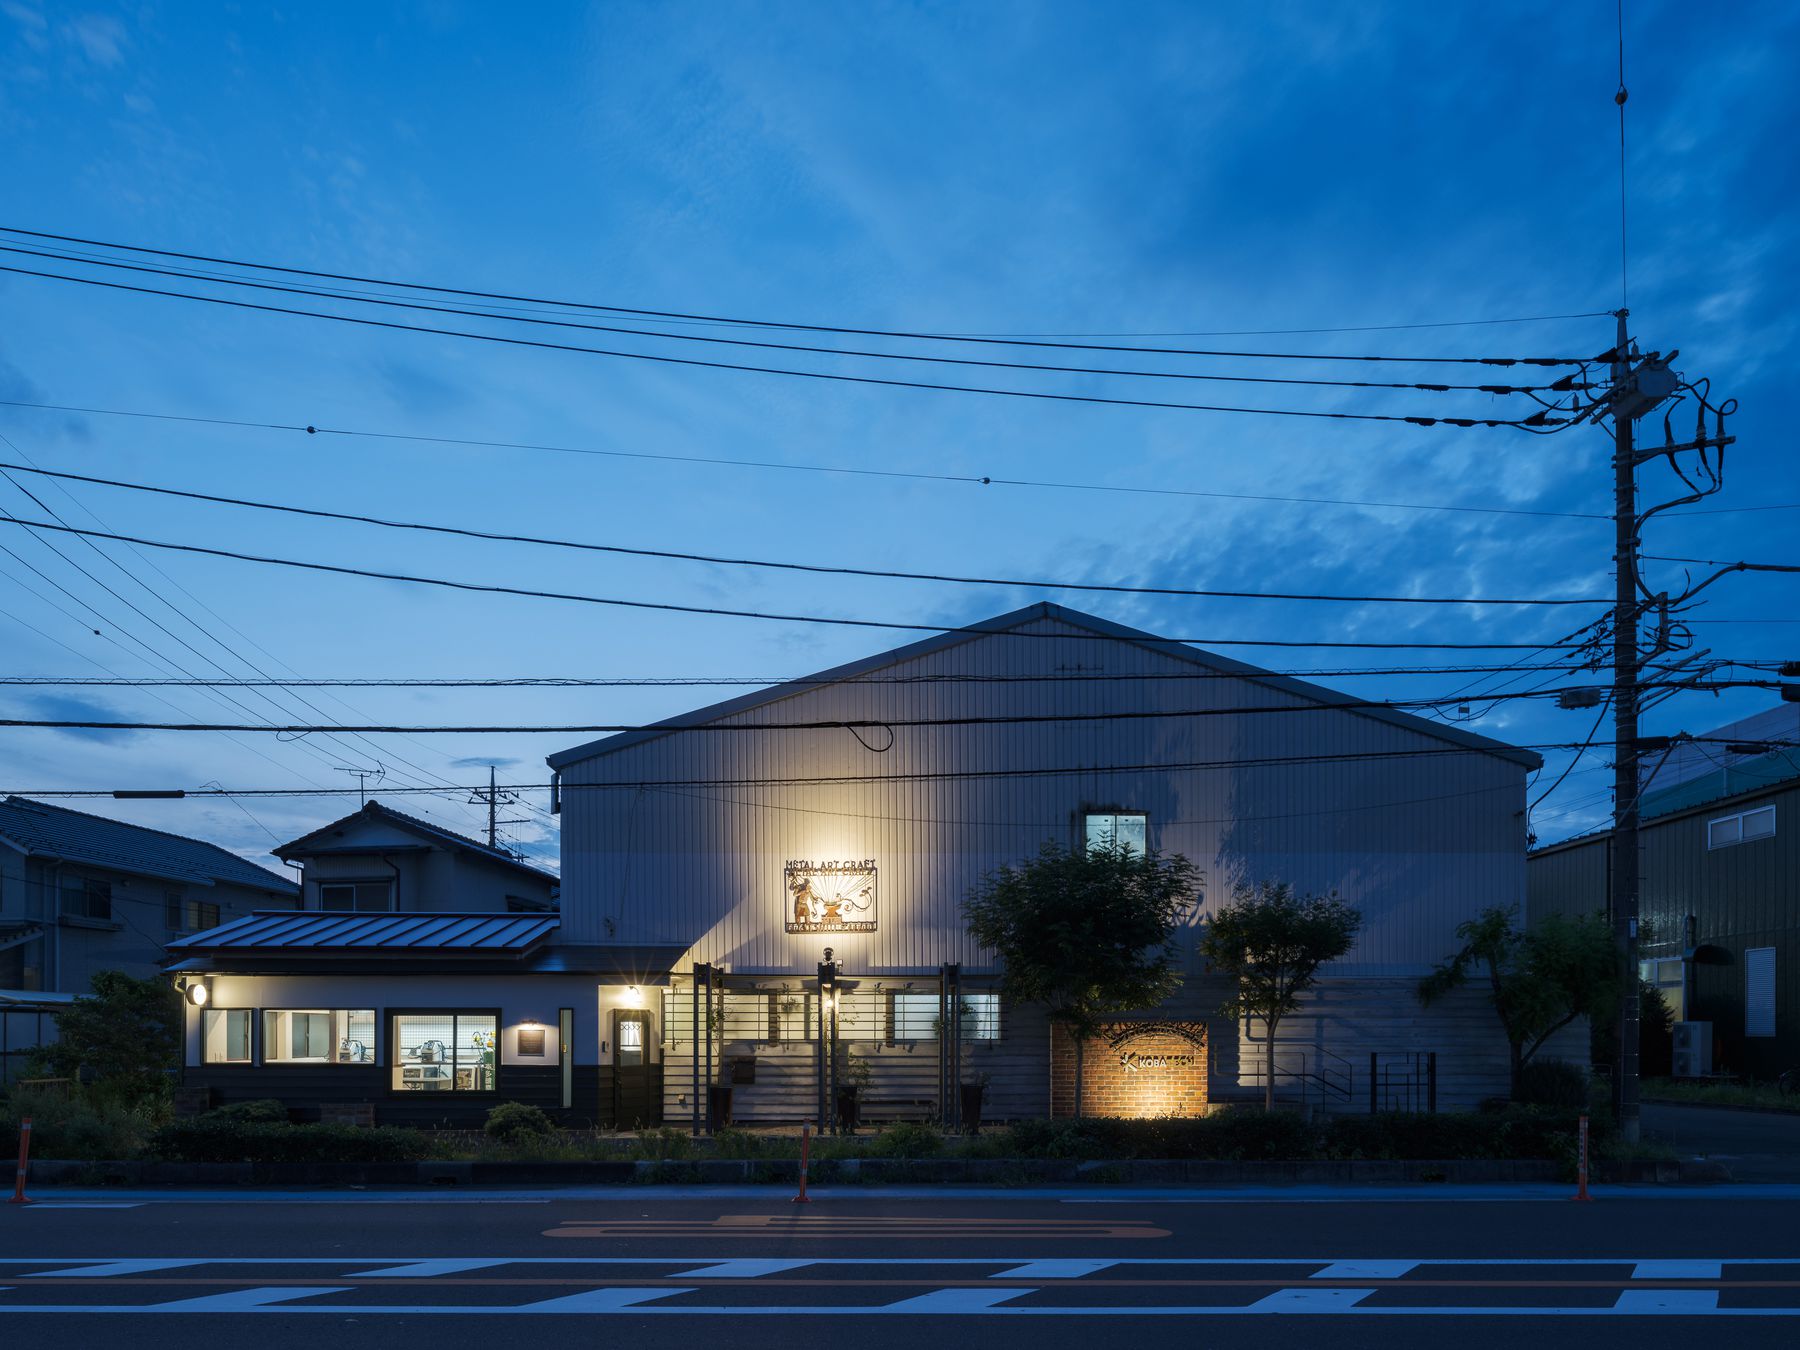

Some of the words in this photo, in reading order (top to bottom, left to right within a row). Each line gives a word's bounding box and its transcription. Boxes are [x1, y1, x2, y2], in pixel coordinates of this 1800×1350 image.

[785, 859, 815, 869] METAL
[820, 860, 839, 870] ART
[843, 859, 875, 870] CRAFT
